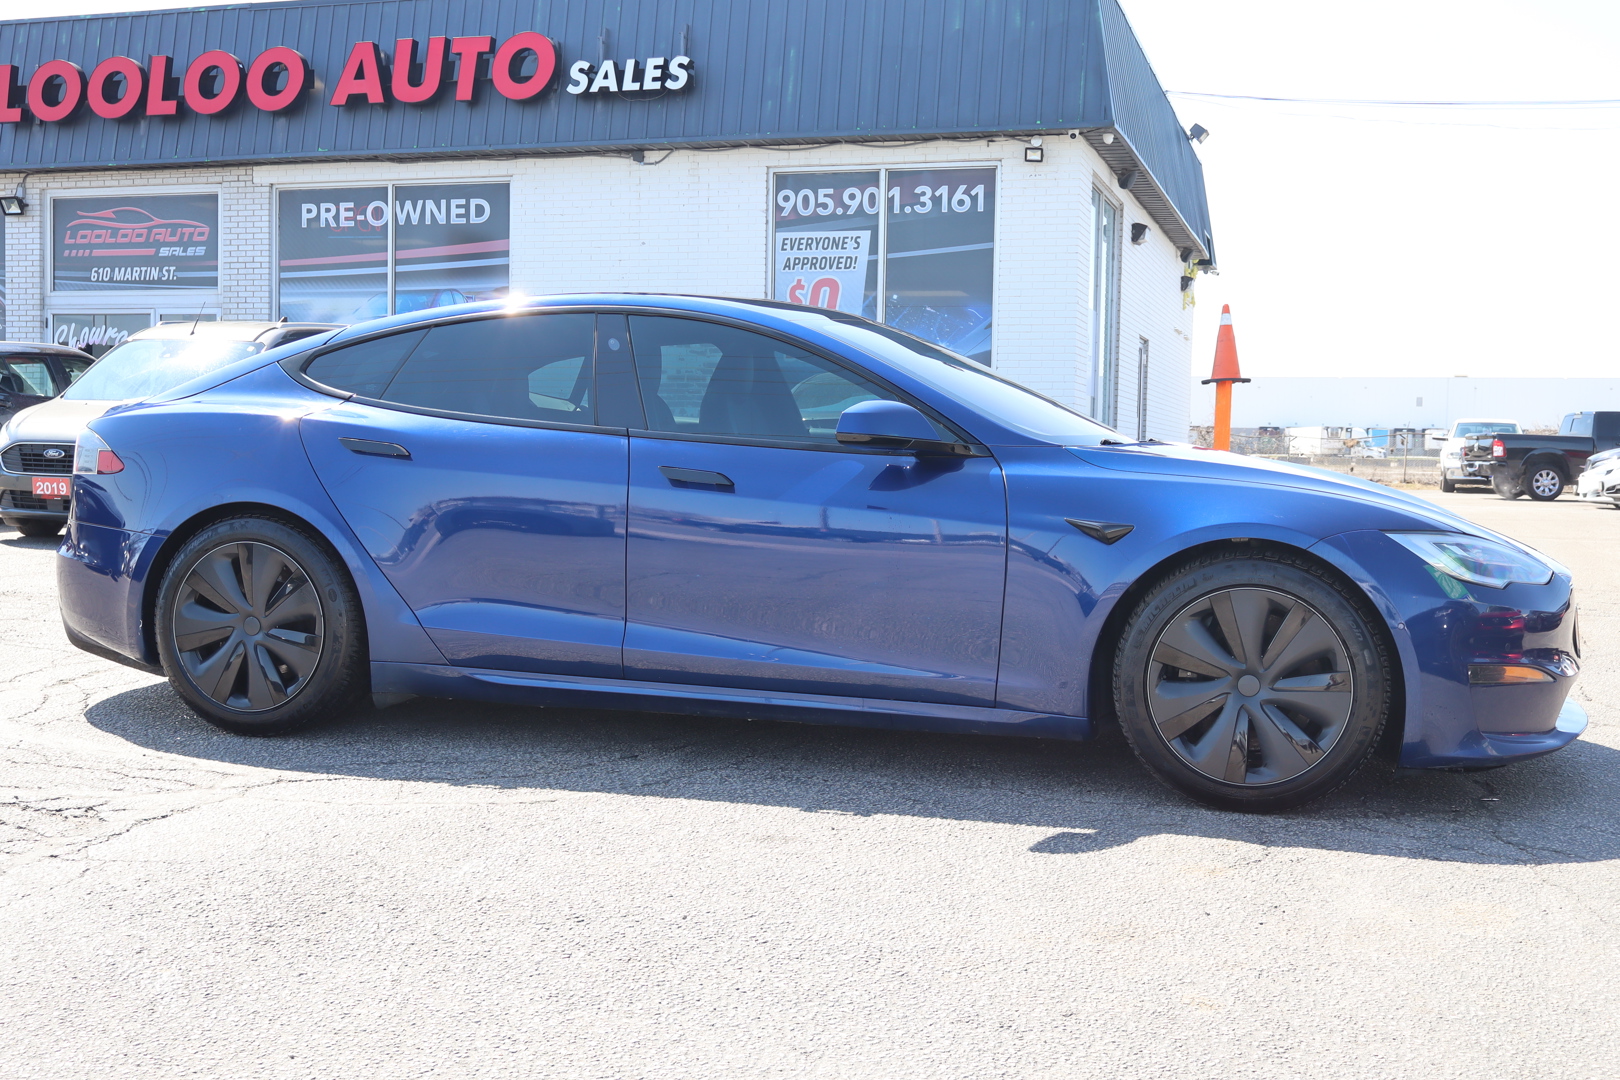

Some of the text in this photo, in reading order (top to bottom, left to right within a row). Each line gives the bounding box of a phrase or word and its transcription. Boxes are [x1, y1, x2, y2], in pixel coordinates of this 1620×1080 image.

[0, 31, 690, 122] LOOLOO AUTO SALES
[776, 184, 985, 217] 905.901.3161
[301, 198, 490, 228] PRE-OWNED
[64, 228, 210, 244] LOOLOO AUTO
[780, 235, 861, 251] EVERYONE'S
[158, 246, 206, 257] SALES
[783, 256, 858, 271] APPROVED!
[90, 266, 177, 281] 610 MARTIN ST.
[36, 482, 67, 495] 2019
